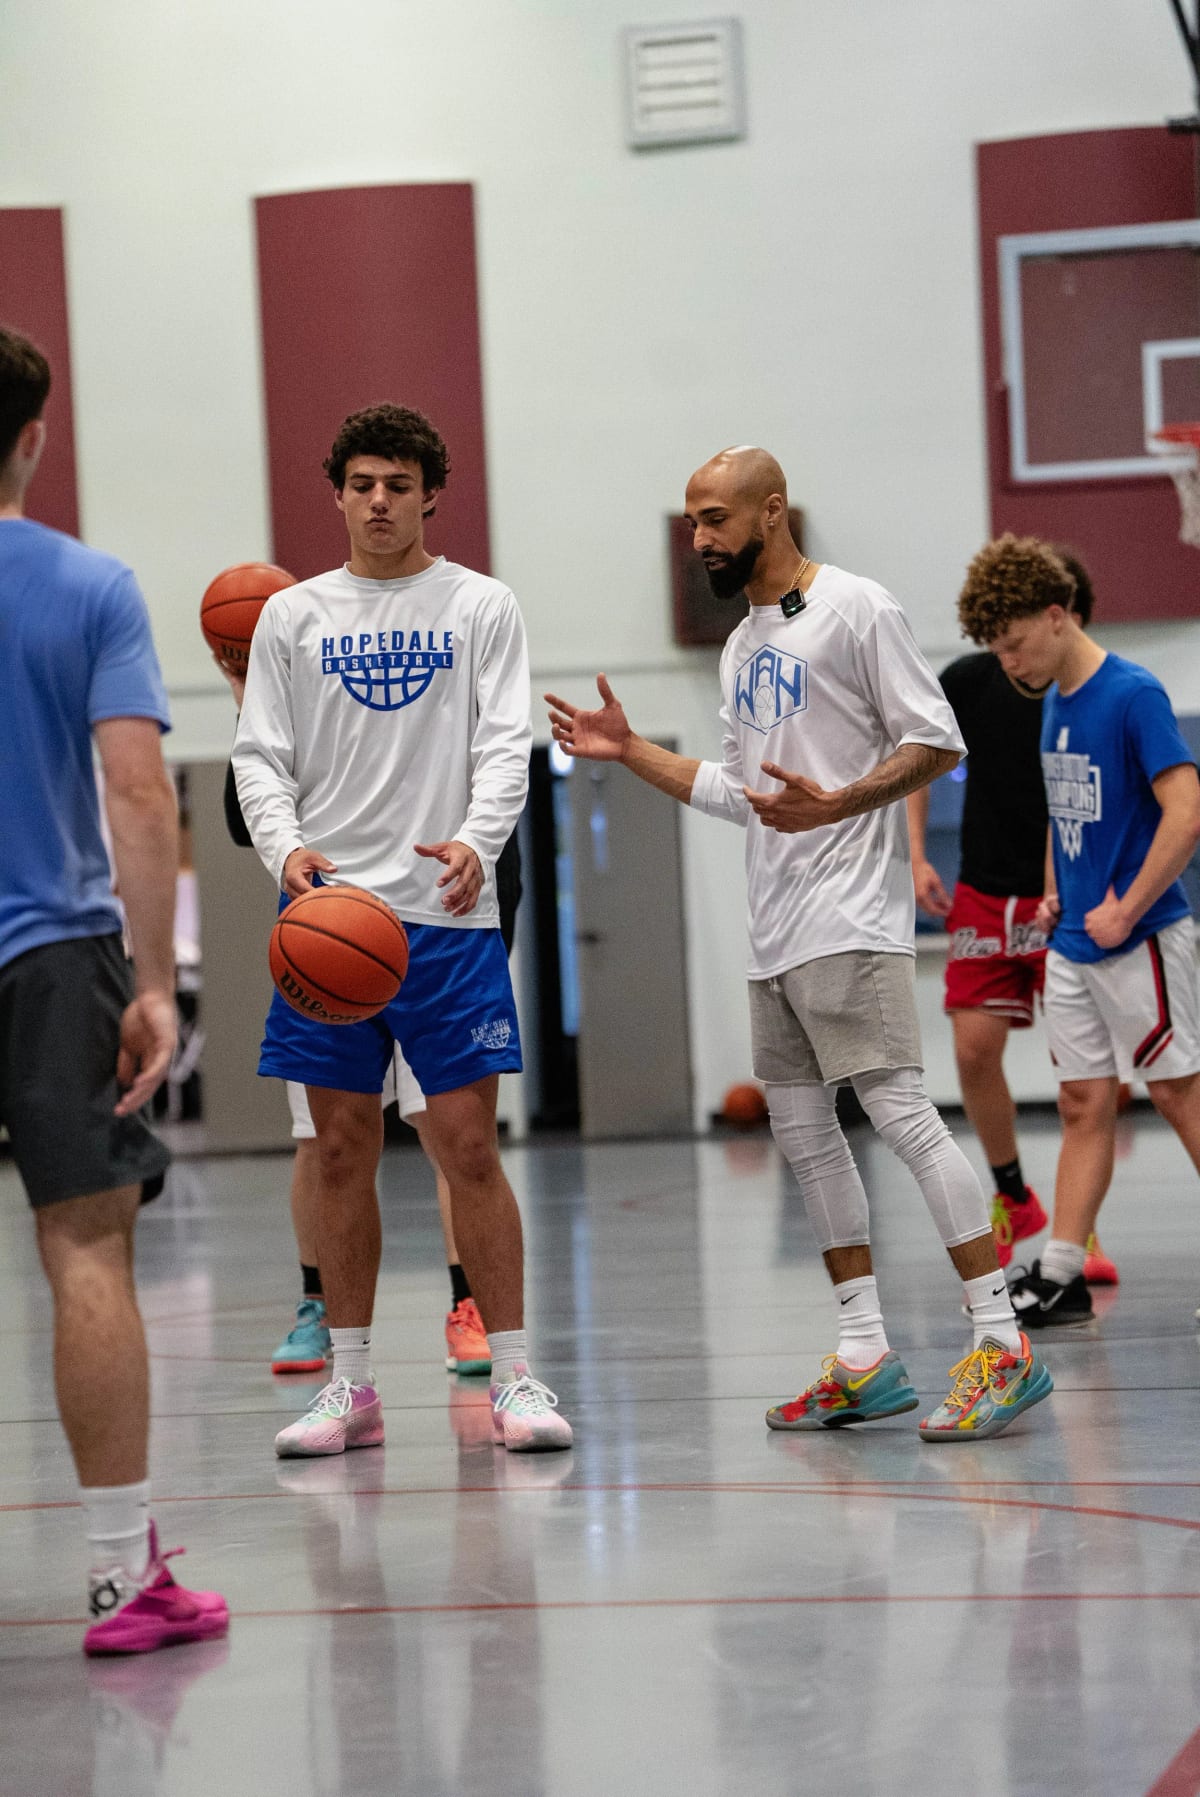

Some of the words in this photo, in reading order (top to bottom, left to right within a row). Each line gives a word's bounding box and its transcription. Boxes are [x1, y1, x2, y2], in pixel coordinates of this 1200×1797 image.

[322, 631, 453, 657] HOPEDALE
[325, 654, 450, 672] BASKETBALL
[735, 649, 801, 722] WAN
[280, 968, 361, 1020] Wilson
